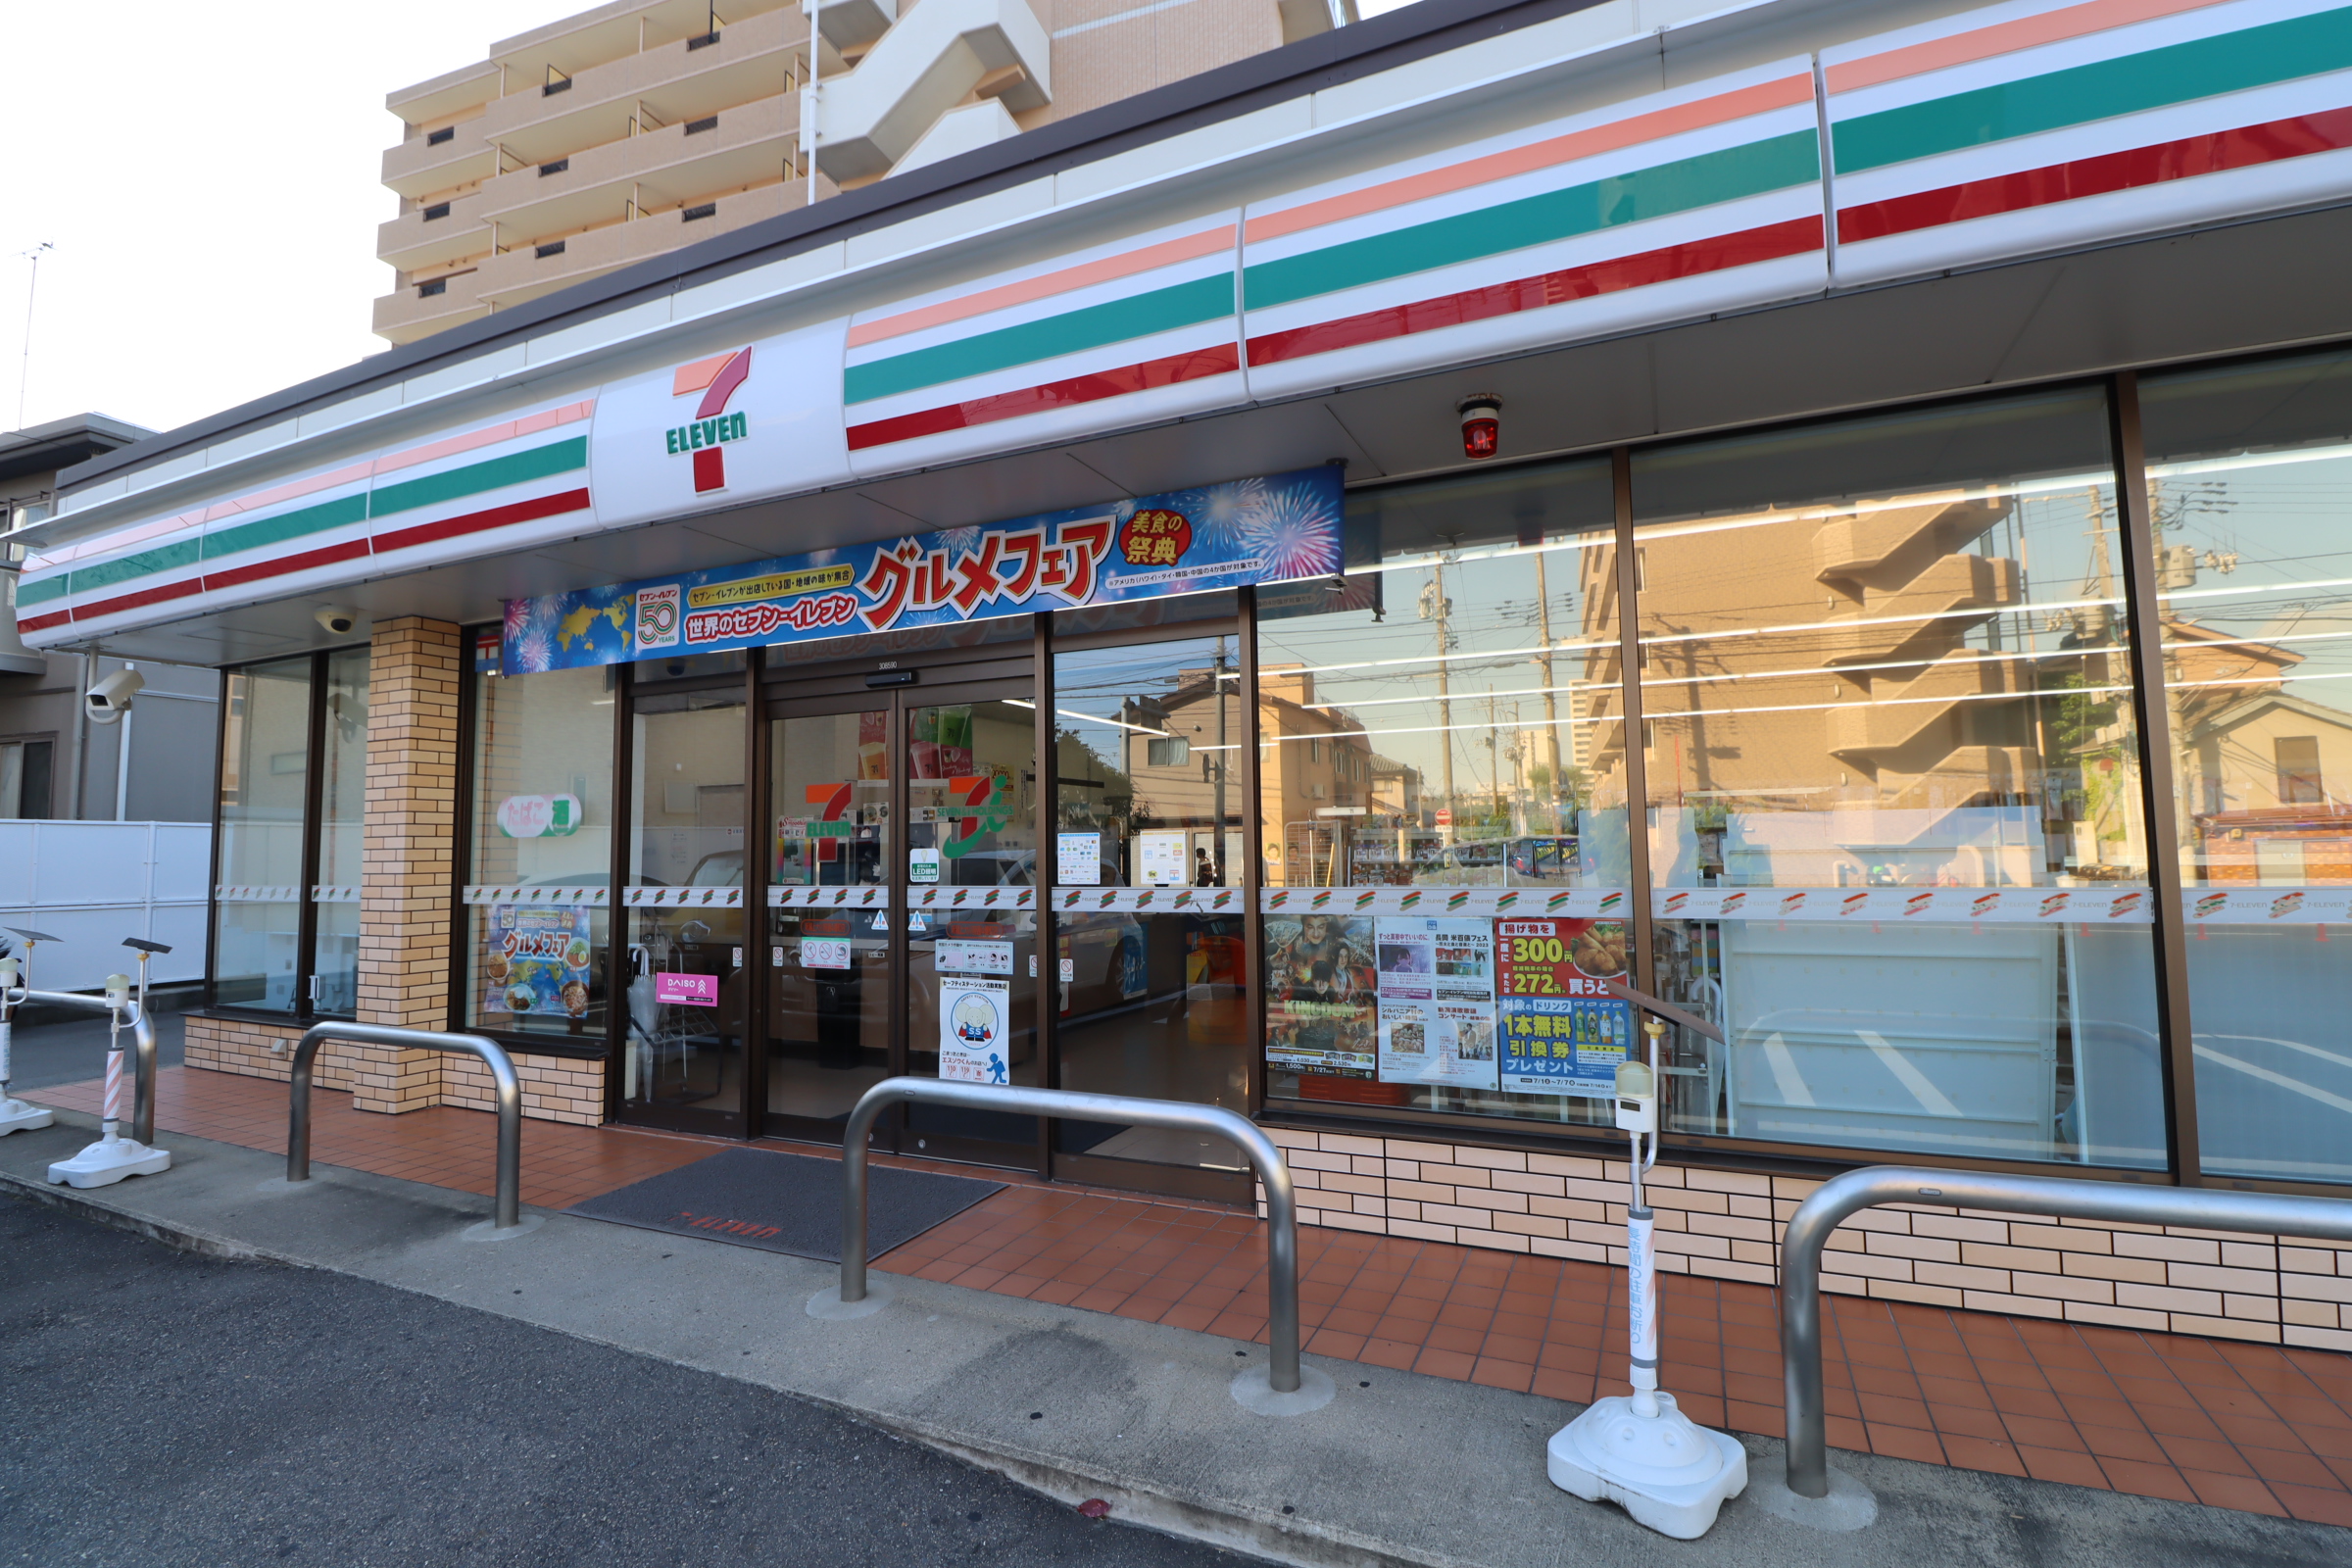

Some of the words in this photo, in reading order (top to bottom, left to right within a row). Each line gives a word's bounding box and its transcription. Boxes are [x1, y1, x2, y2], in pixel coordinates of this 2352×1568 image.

[1131, 511, 1183, 535] 美食の
[1126, 535, 1178, 564] 祭典
[861, 519, 1113, 630] グルメフェア
[638, 600, 677, 645] 50
[507, 800, 545, 826] たばこ
[972, 806, 1014, 815] HOLDINGS
[1504, 923, 1550, 935] 揚げ物を
[502, 930, 571, 959] グルメフェア
[1499, 938, 1509, 962] 一度に
[667, 978, 696, 988] DAISO
[1568, 978, 1610, 995] 買うと
[1284, 999, 1356, 1018] KINGDOM
[1502, 998, 1532, 1011] 対象の
[1535, 1001, 1569, 1010] ドリンク
[1502, 1013, 1572, 1039] 1本無料
[1508, 1040, 1570, 1058] 引換券
[1505, 1058, 1574, 1074] プレゼント
